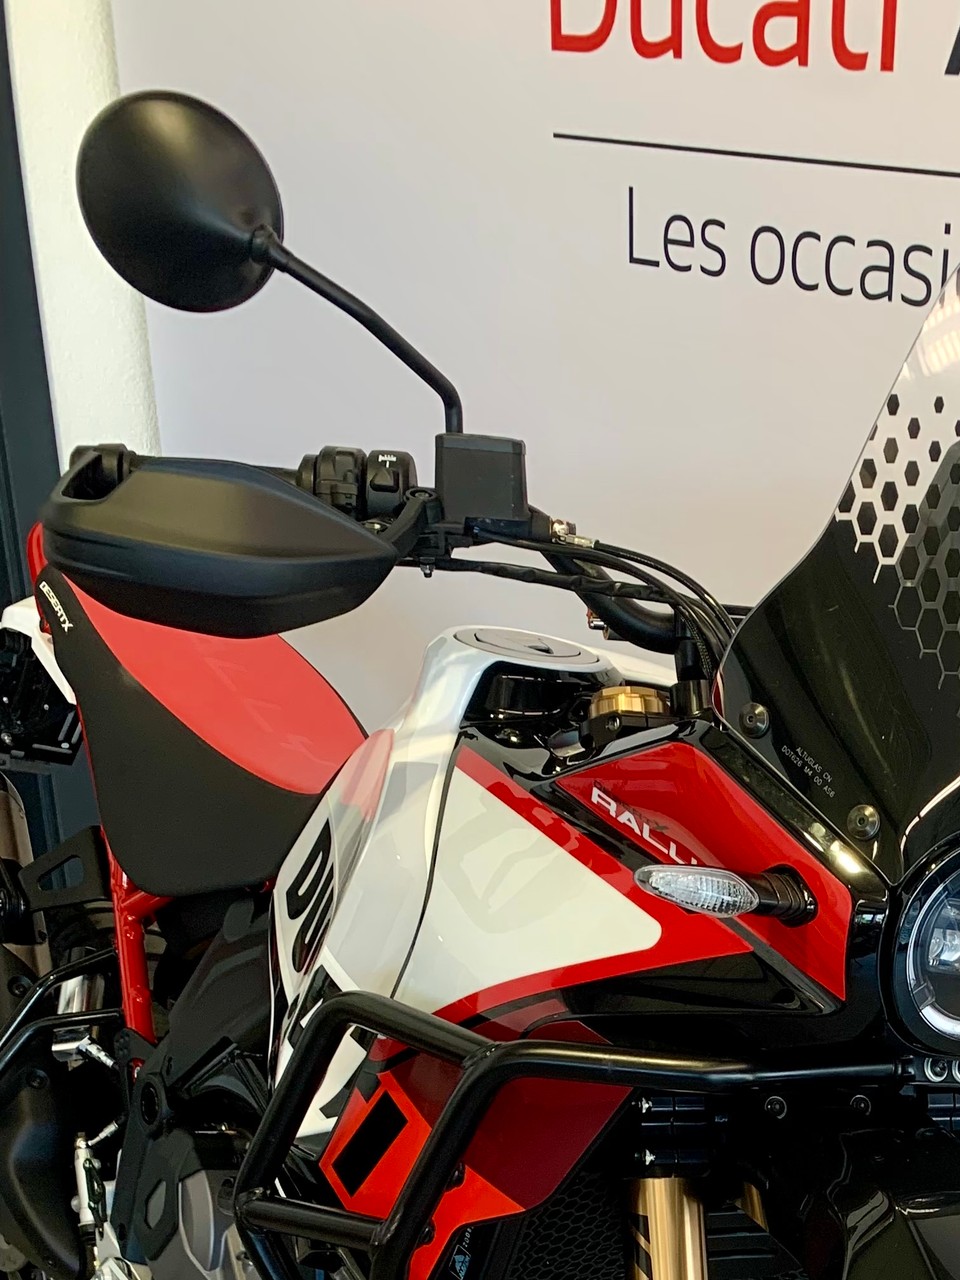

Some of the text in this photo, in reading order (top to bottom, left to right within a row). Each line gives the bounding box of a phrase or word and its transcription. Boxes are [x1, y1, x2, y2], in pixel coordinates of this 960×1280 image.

[627, 186, 727, 278] Les
[39, 581, 74, 633] DESERTX
[591, 786, 698, 865] RALL
